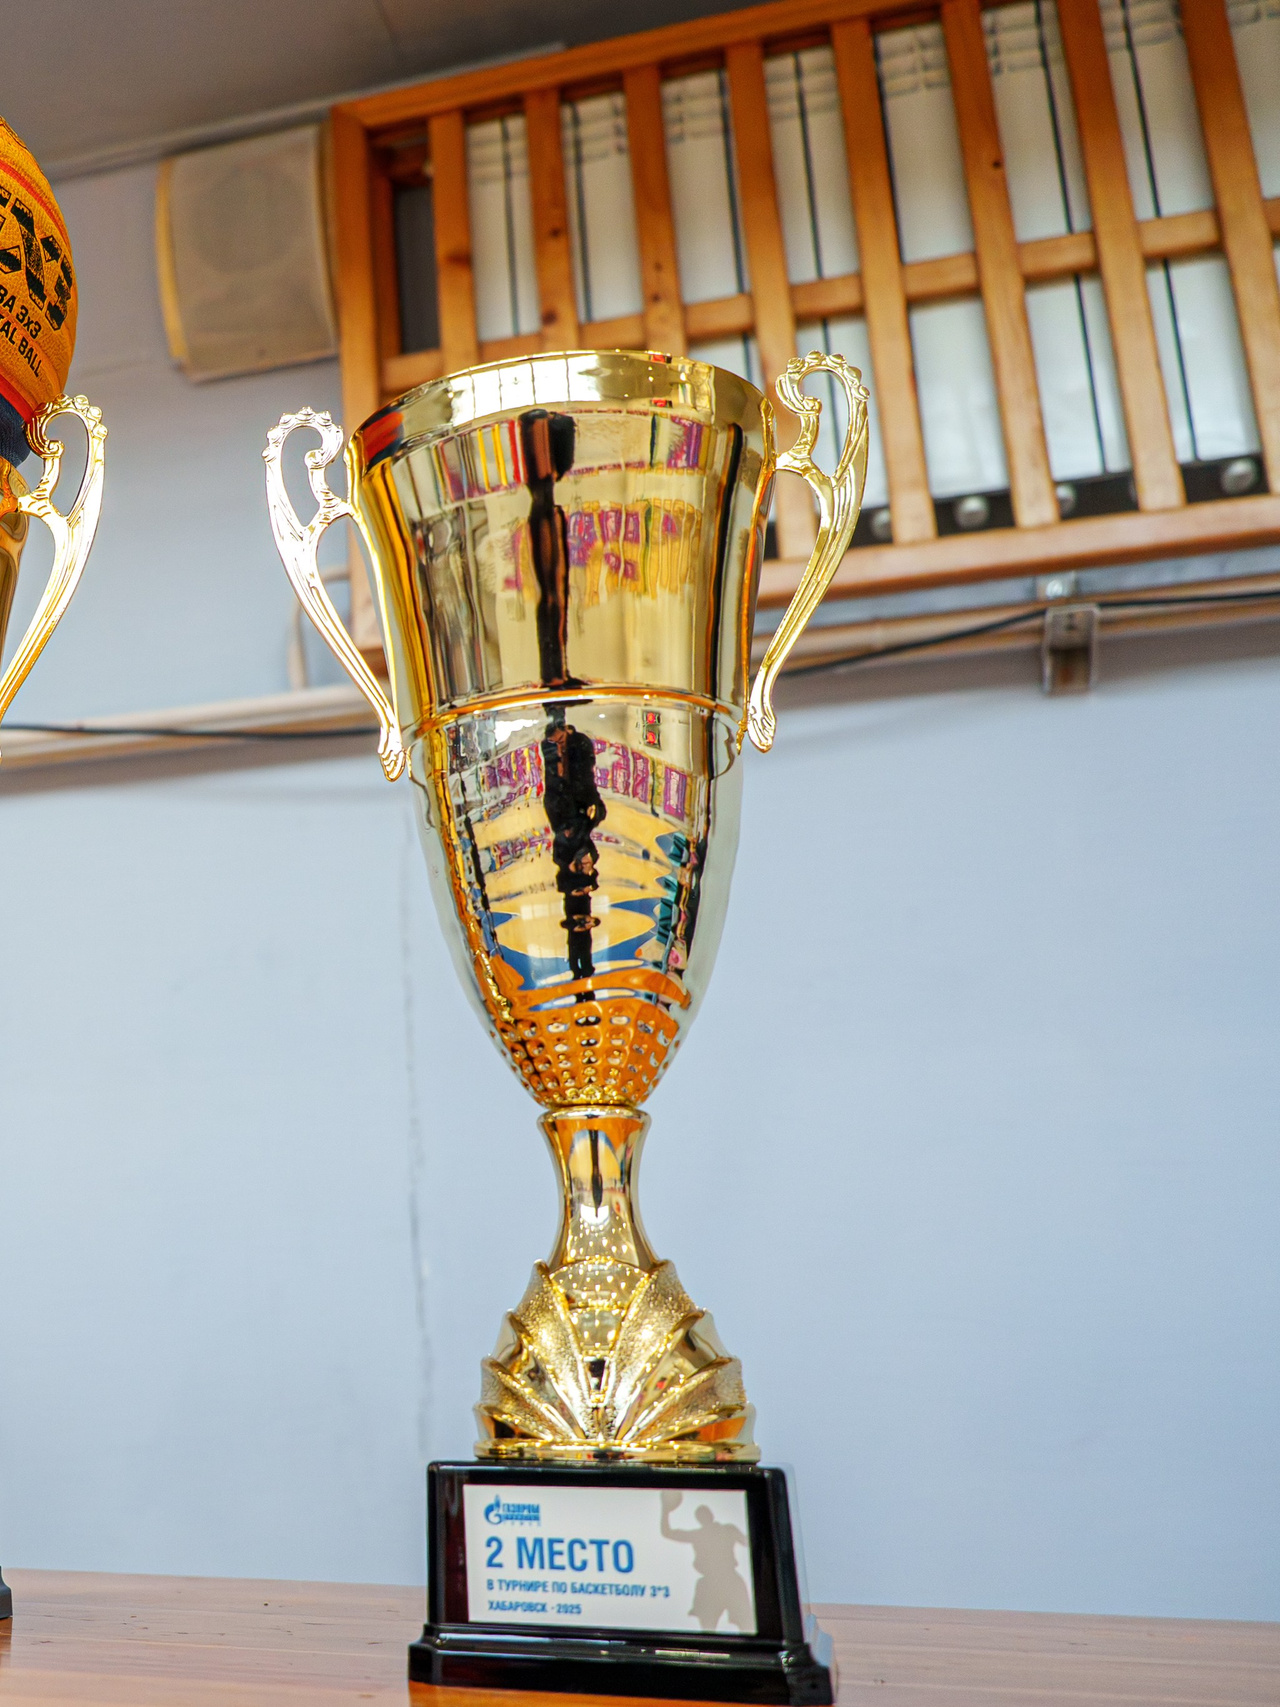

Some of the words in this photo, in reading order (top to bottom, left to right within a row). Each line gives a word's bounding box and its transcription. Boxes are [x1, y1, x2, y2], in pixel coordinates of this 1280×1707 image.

[18, 338, 43, 378] BALL
[485, 1536, 503, 1568] 2
[516, 1536, 634, 1573] МЕСТО
[487, 1579, 494, 1591] В
[497, 1579, 549, 1592] ТУРНИРЕ
[552, 1582, 567, 1593] ПО
[570, 1582, 646, 1597] БАСКЕТБОЛУ
[488, 1600, 548, 1612] ХАБАРОВСК
[556, 1603, 582, 1614] 2025
